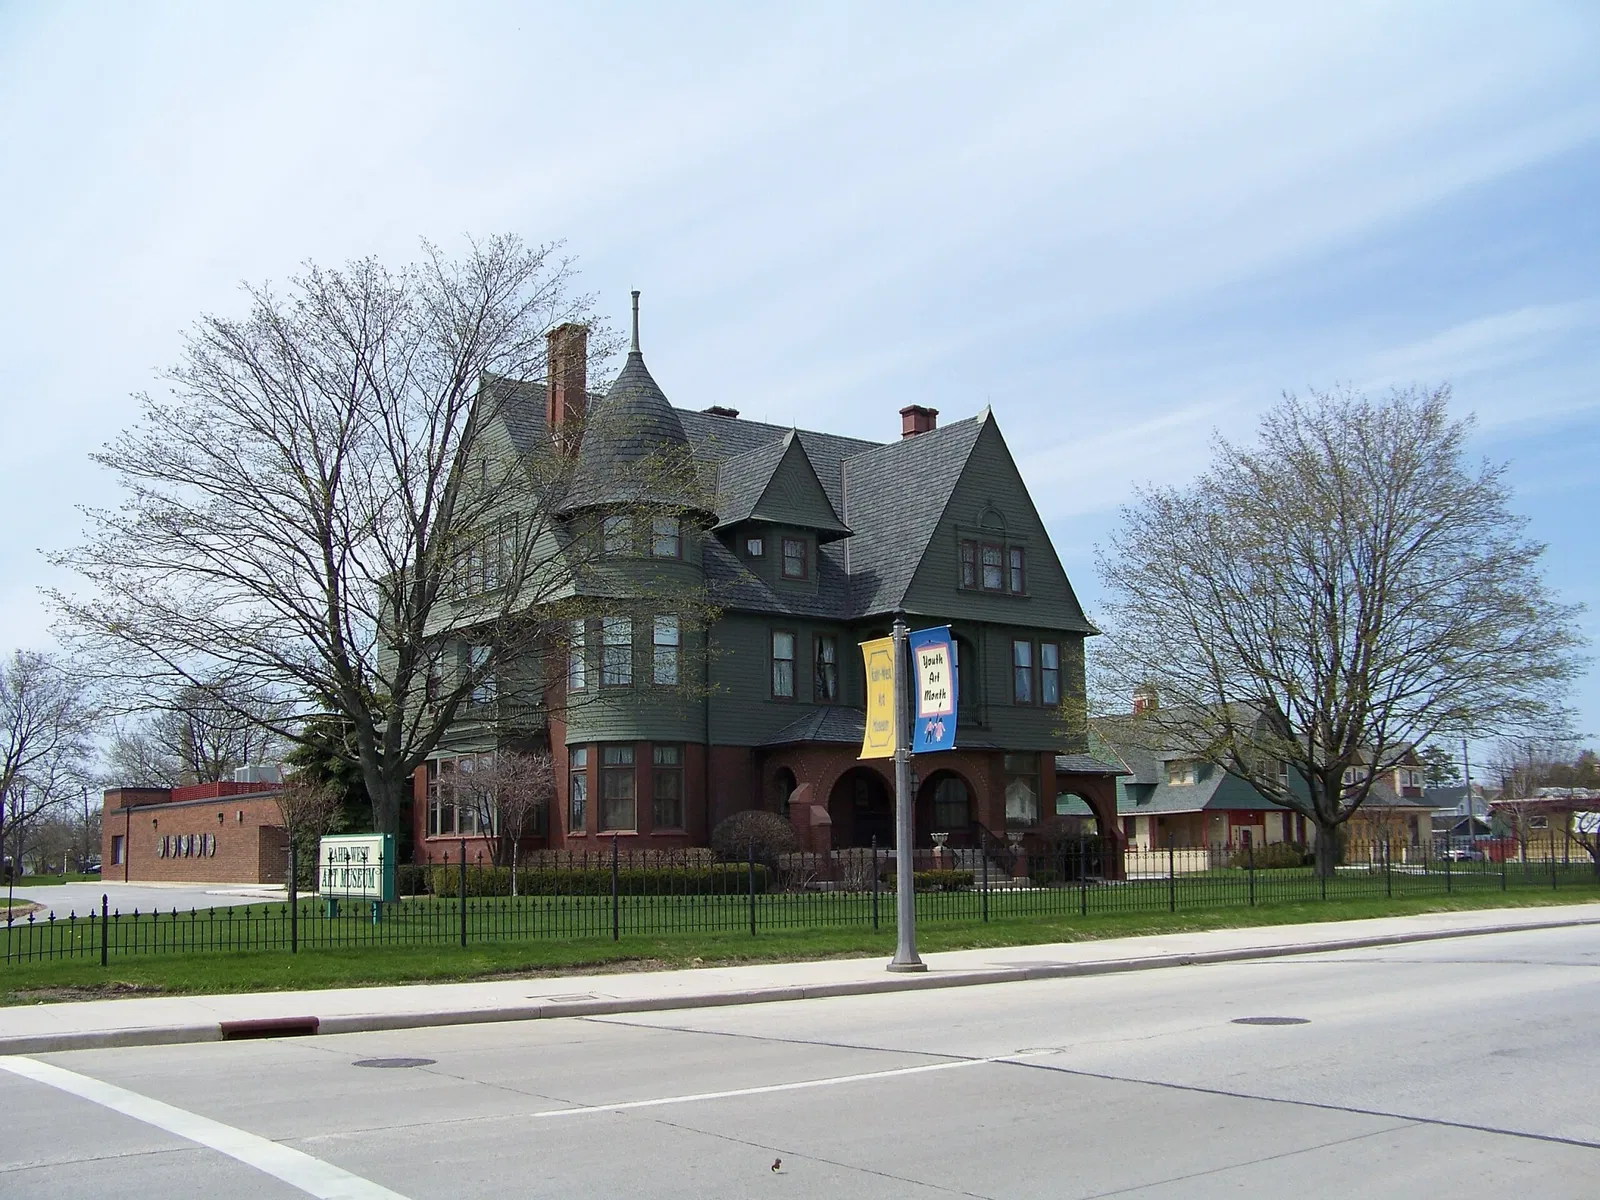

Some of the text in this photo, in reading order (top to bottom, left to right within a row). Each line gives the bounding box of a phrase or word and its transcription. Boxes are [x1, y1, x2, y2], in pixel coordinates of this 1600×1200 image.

[923, 653, 943, 668] Youth
[929, 672, 940, 684] Art
[924, 689, 947, 701] Month
[340, 868, 375, 888] MUSEUM
